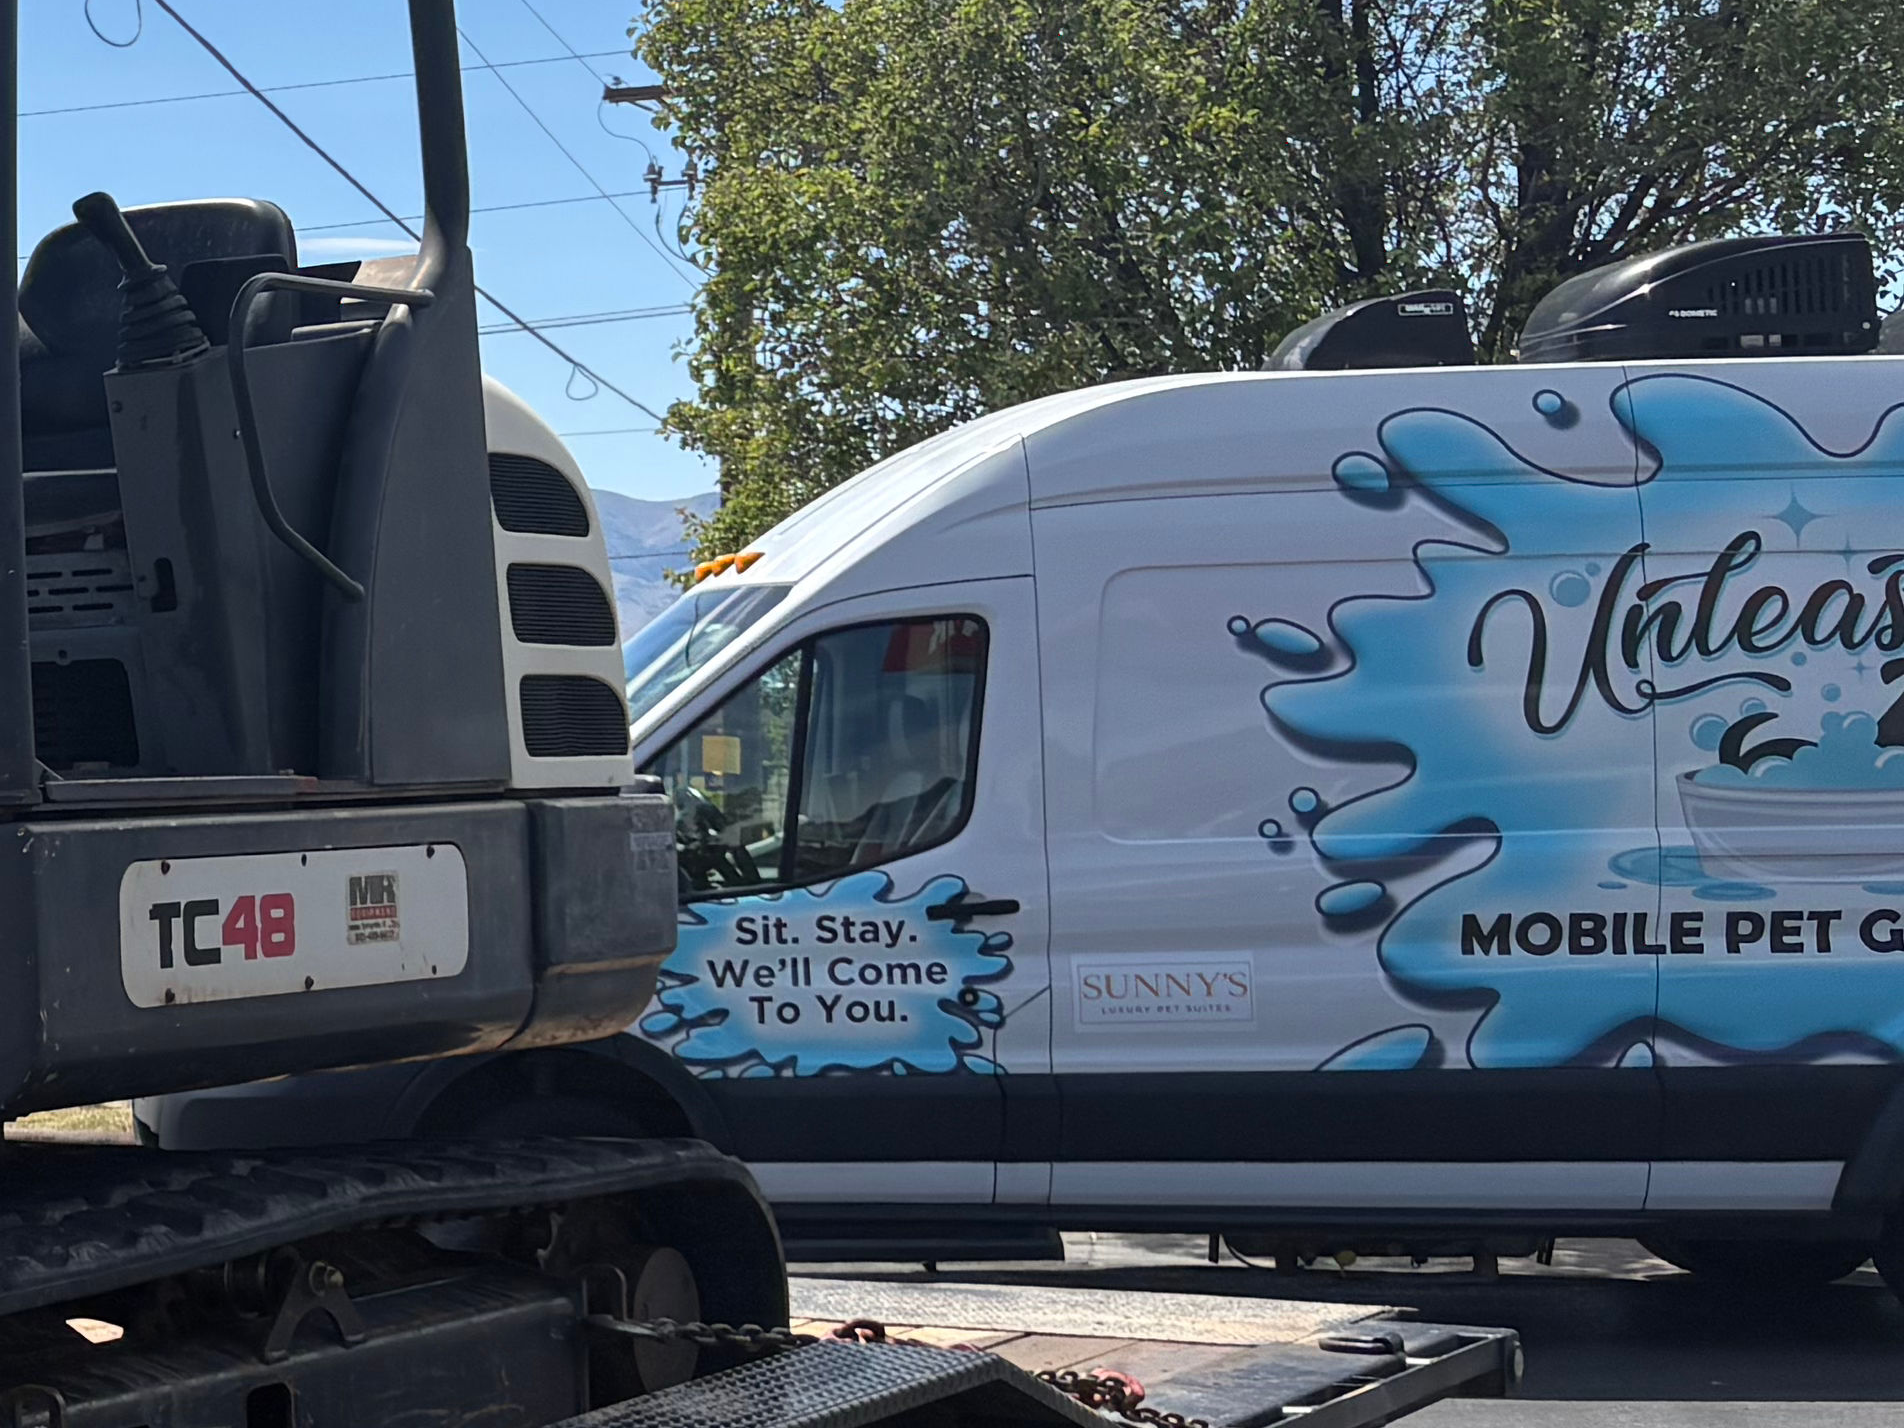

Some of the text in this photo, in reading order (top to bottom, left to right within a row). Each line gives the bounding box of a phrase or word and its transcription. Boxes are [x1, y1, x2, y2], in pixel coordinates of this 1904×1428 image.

[149, 892, 296, 970] TC48
[735, 914, 918, 949] Sit. Stay.
[1461, 909, 1904, 956] MOBILE PET G
[827, 956, 949, 986] Come
[749, 995, 909, 1026] To You.
